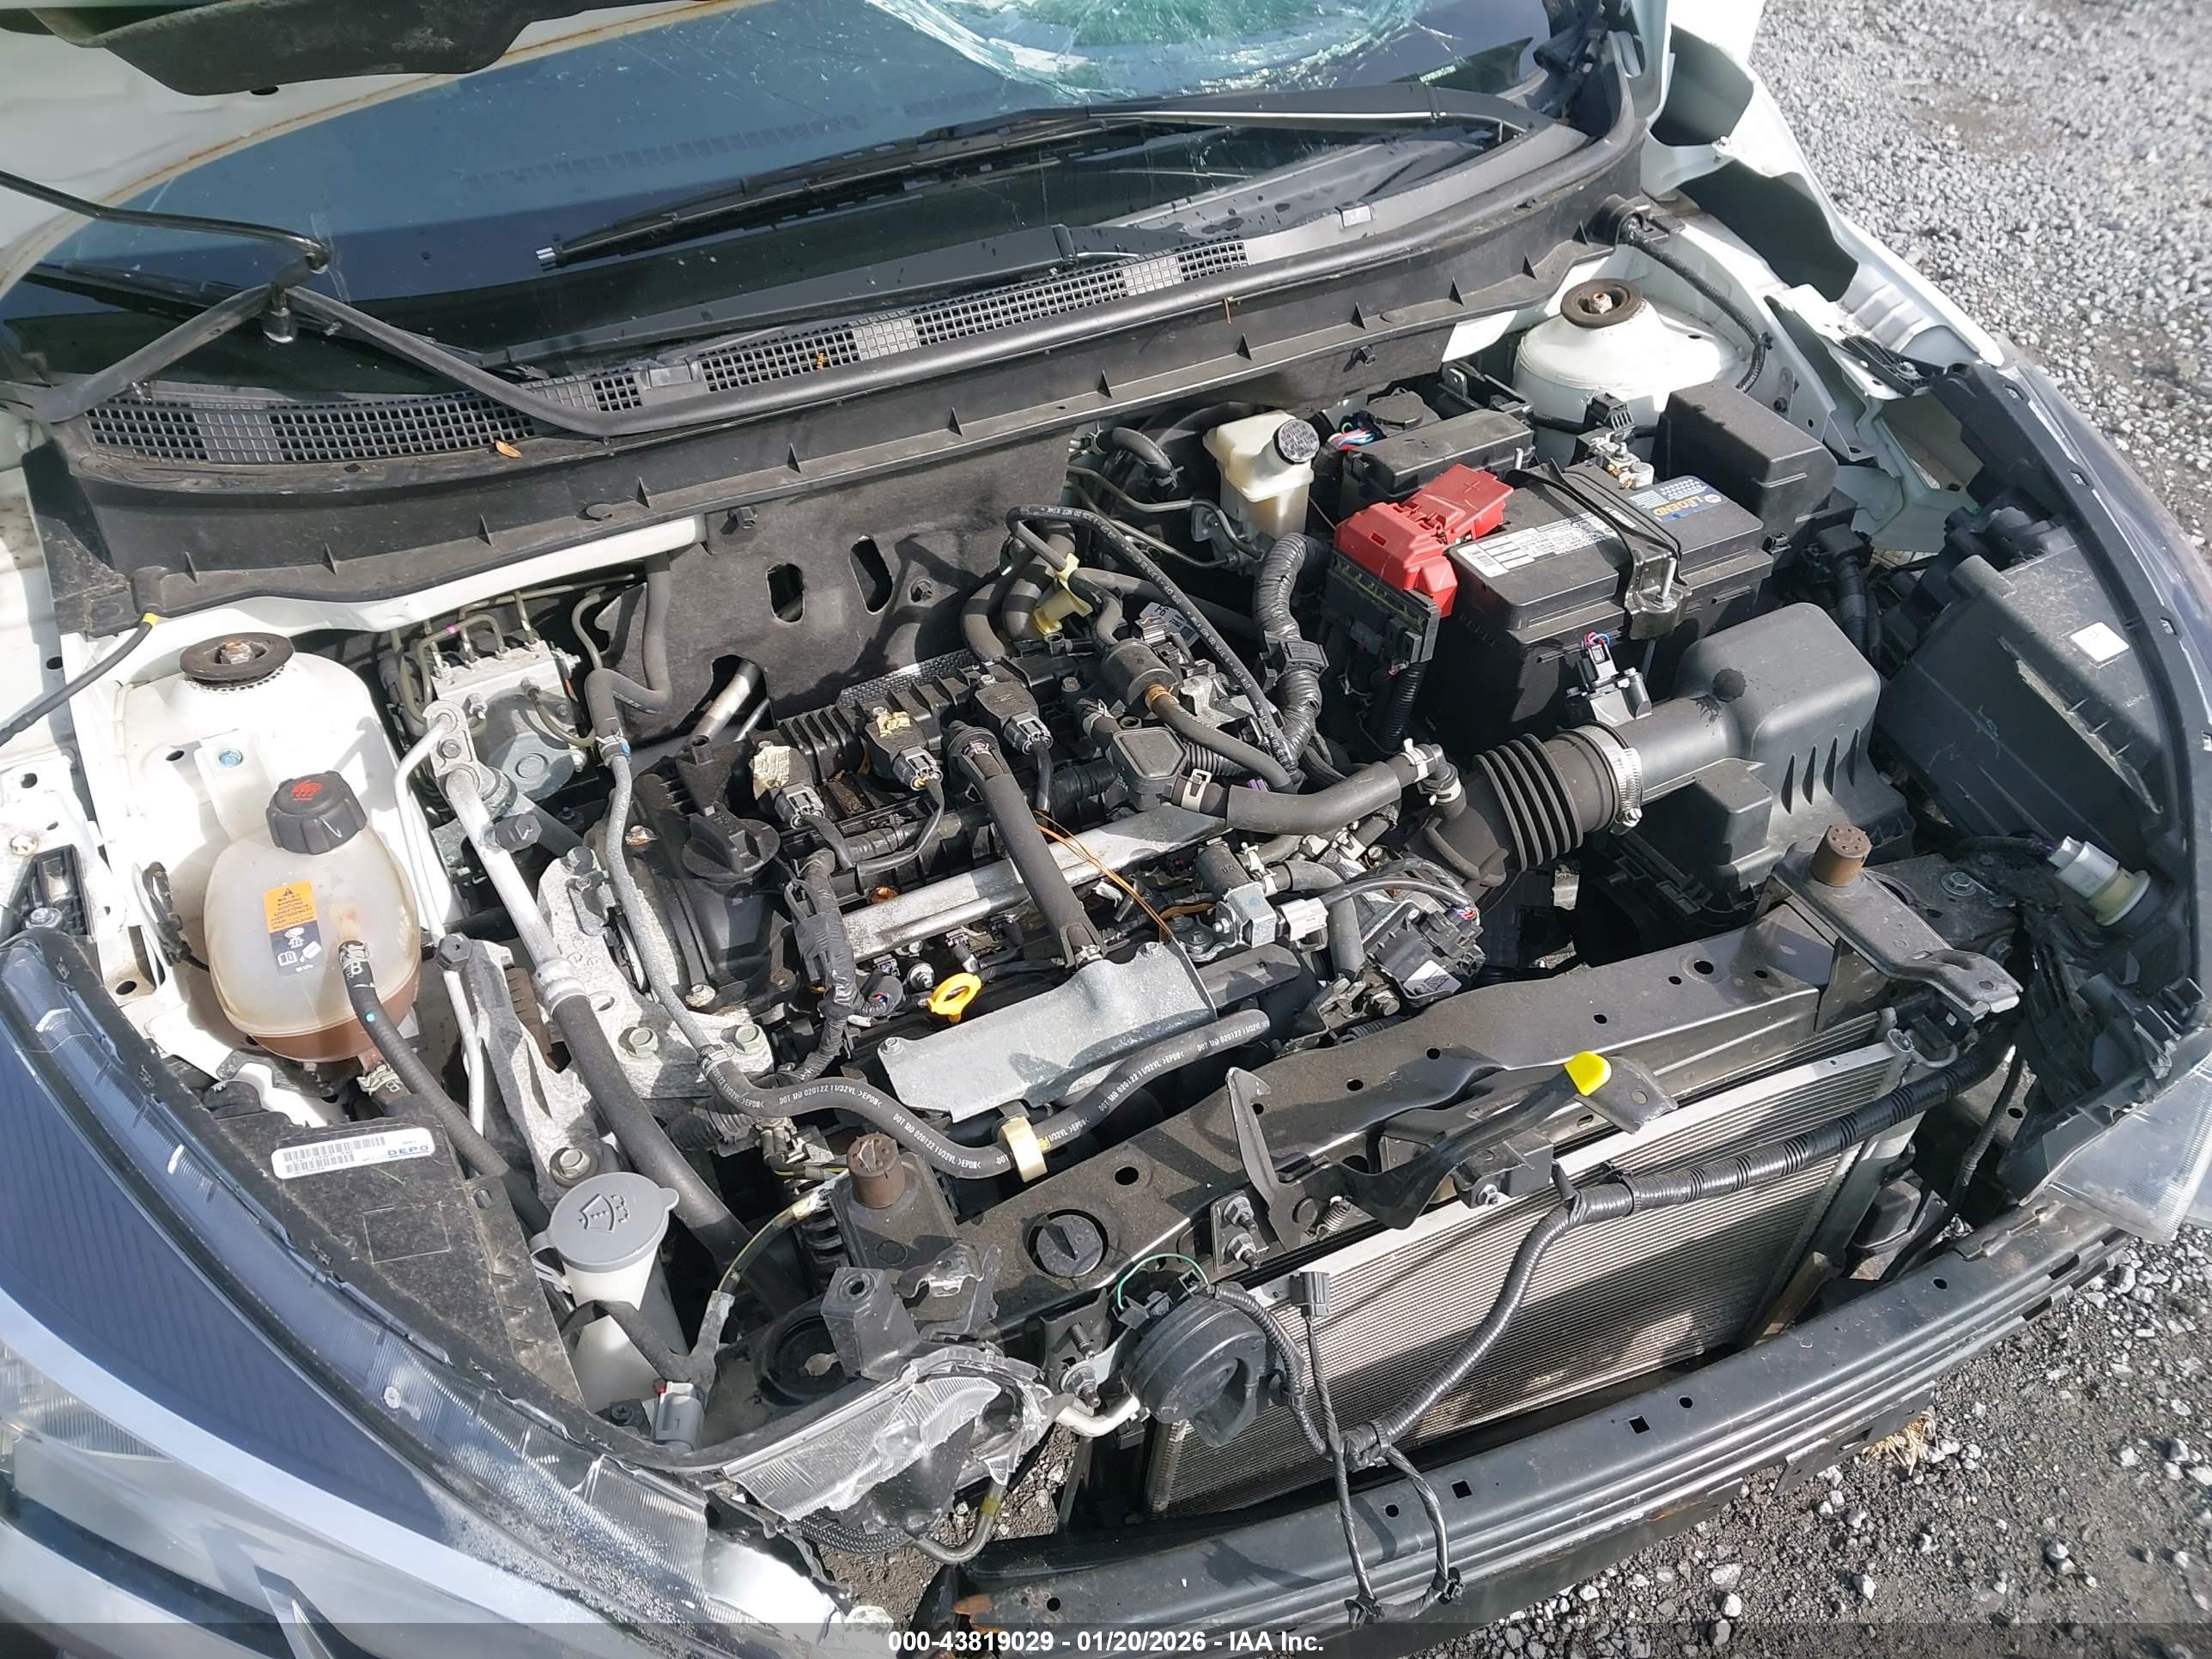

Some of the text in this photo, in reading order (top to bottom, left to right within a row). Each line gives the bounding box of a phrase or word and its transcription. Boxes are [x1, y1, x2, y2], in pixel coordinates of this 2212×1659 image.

[1653, 495, 1704, 515] LEGEND
[1197, 1042, 1207, 1052] DOT
[779, 1095, 791, 1105] DOT
[804, 1085, 829, 1097] 020122
[1097, 1100, 1109, 1112] DOT
[1117, 1073, 1139, 1093] 020122
[893, 1113, 906, 1126] DOT
[914, 1130, 936, 1150] 020122
[387, 1145, 429, 1157] DEPO
